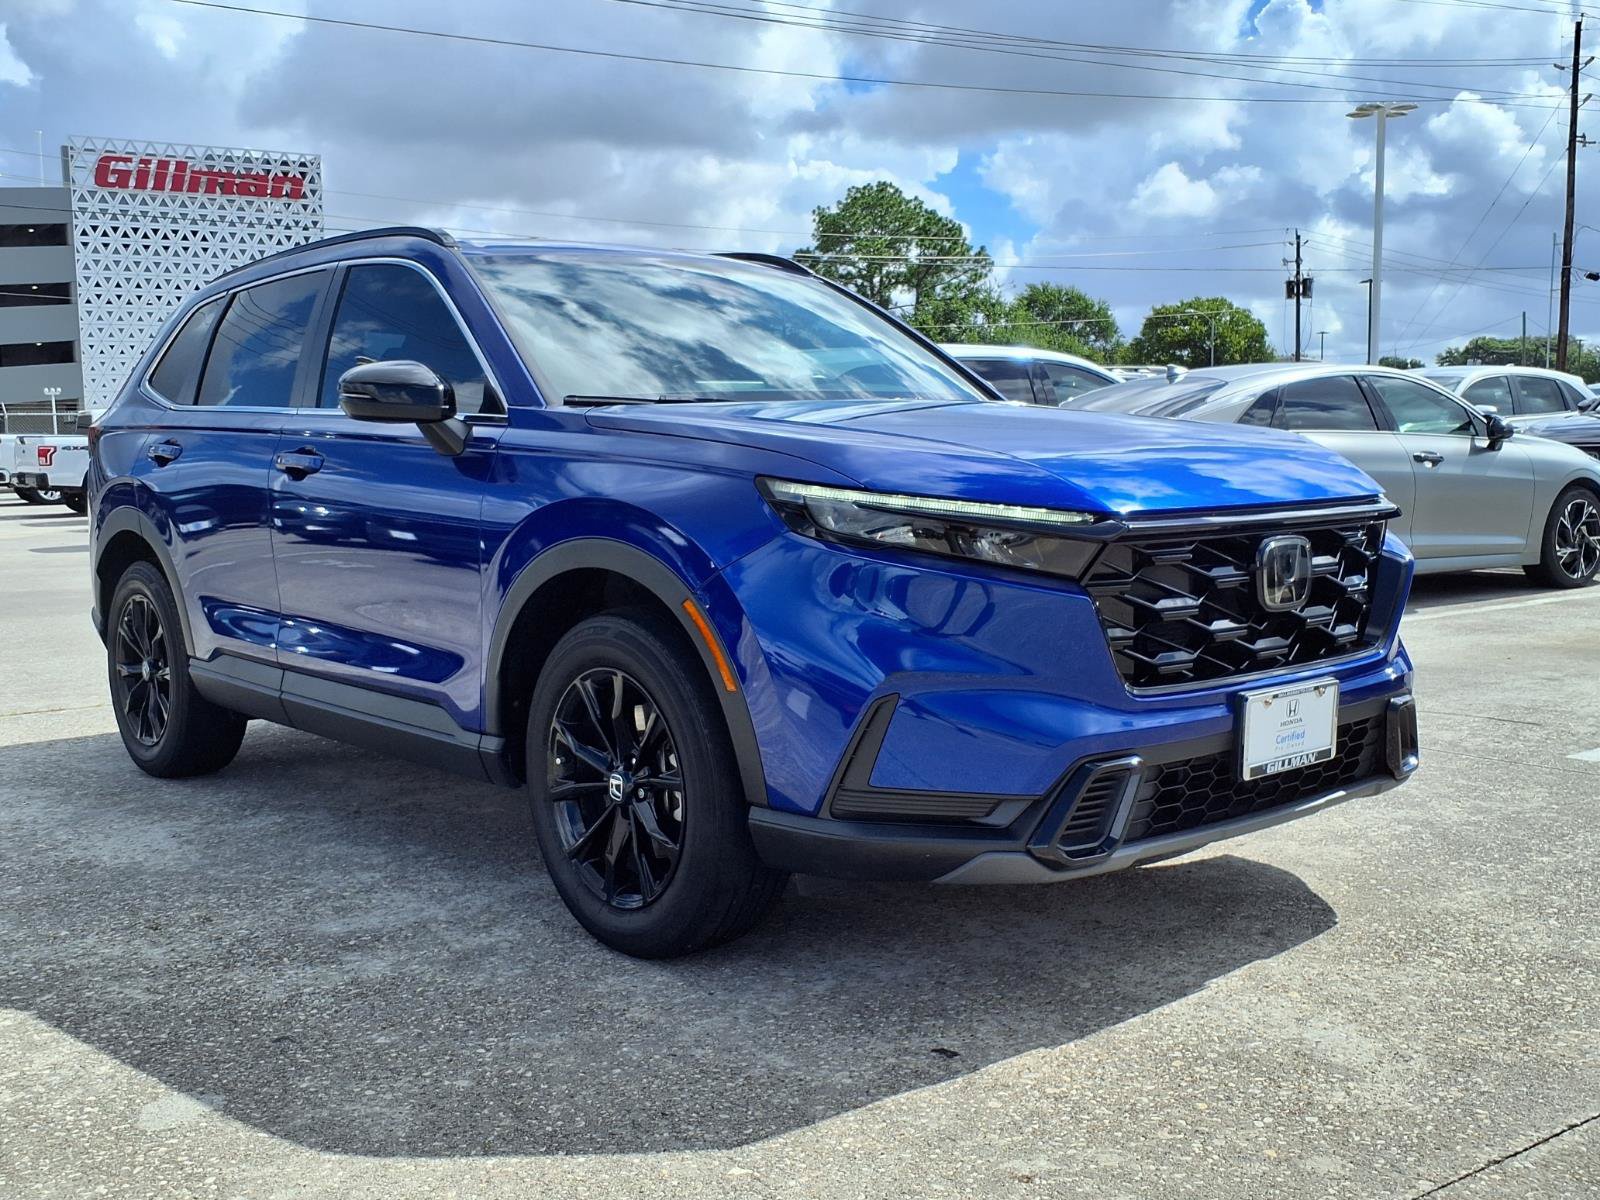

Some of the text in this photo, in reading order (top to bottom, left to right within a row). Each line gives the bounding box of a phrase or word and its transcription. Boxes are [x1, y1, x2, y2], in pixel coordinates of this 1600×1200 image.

[95, 155, 304, 199] Gillman
[1280, 718, 1303, 727] HONDA
[1276, 729, 1305, 744] Certified
[1266, 753, 1316, 774] GILLMAN
